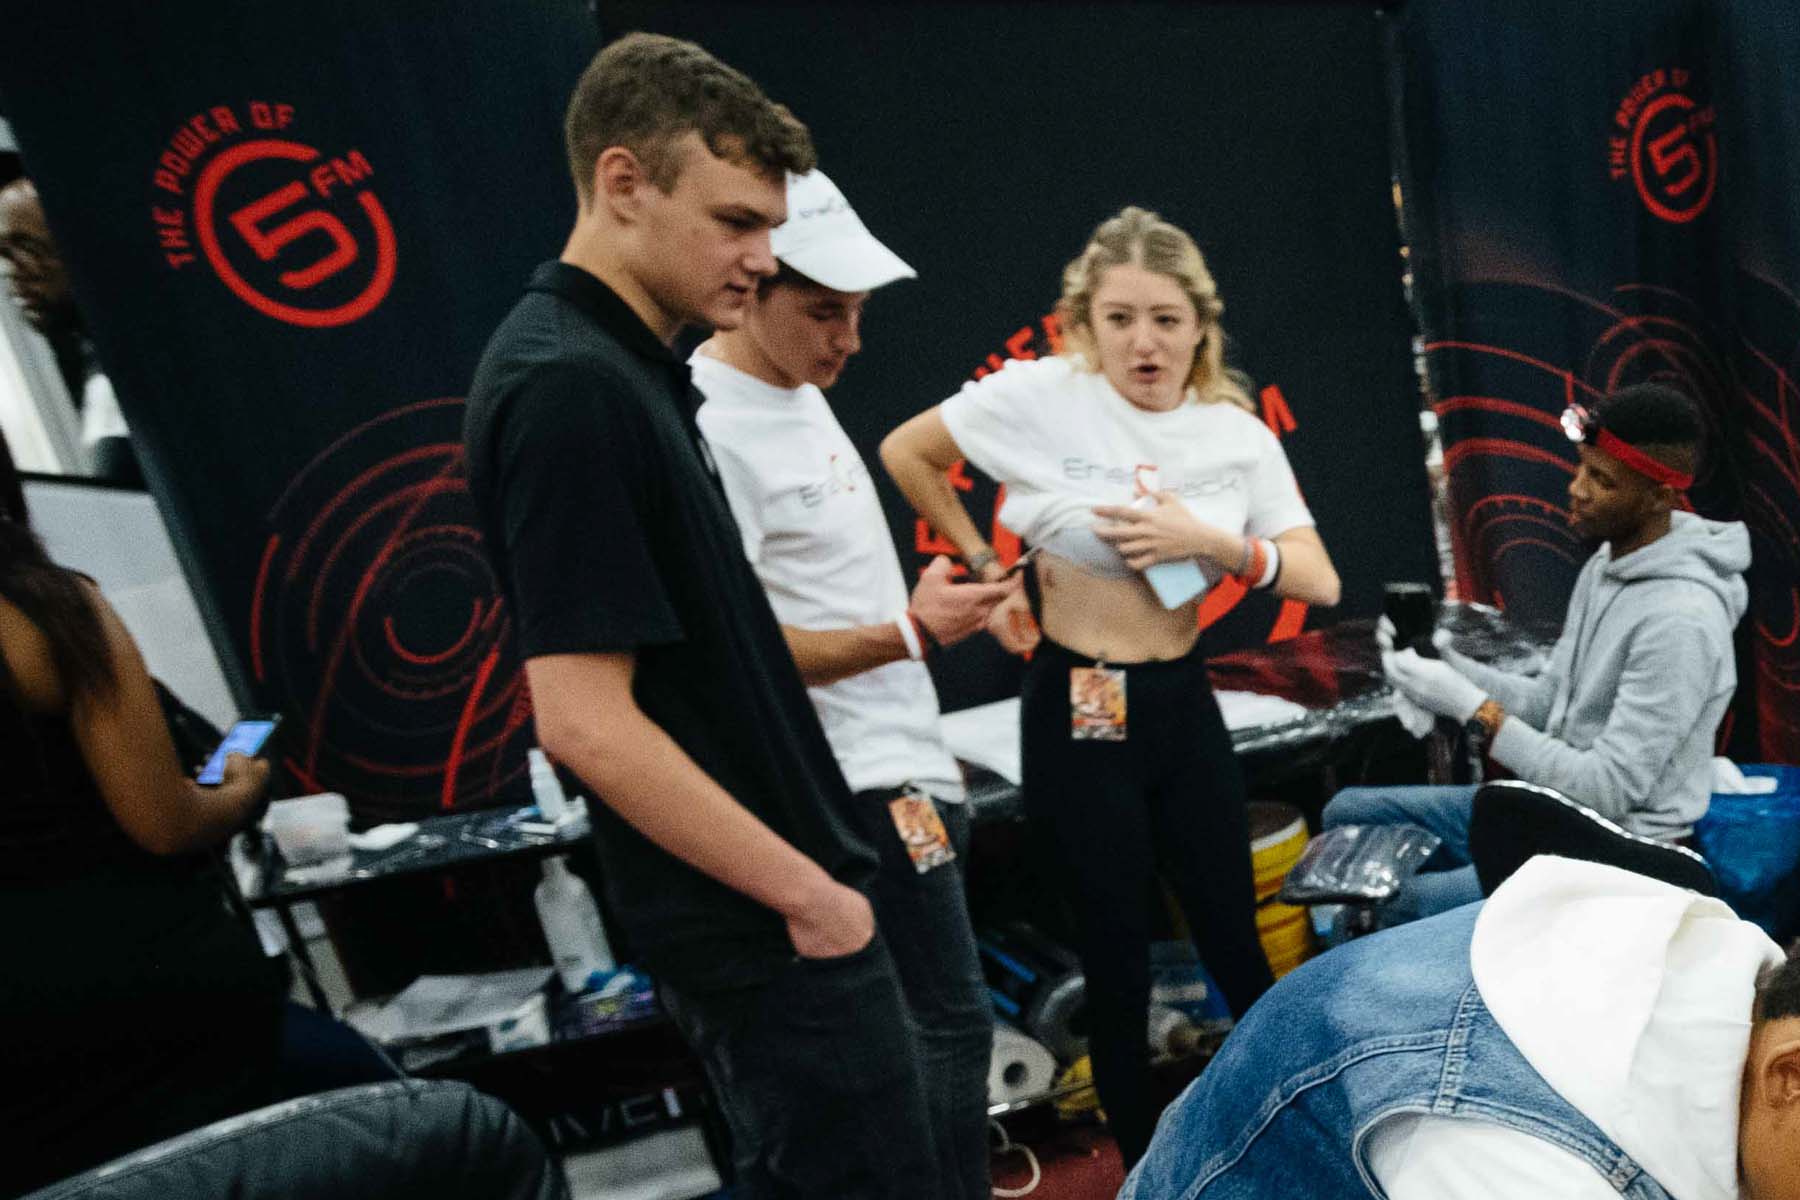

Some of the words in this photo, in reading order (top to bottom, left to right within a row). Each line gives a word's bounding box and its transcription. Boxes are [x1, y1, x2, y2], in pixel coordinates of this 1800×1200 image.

[249, 101, 296, 130] OF
[153, 104, 242, 195] POWER
[309, 149, 375, 199] FM
[151, 205, 198, 270] THE
